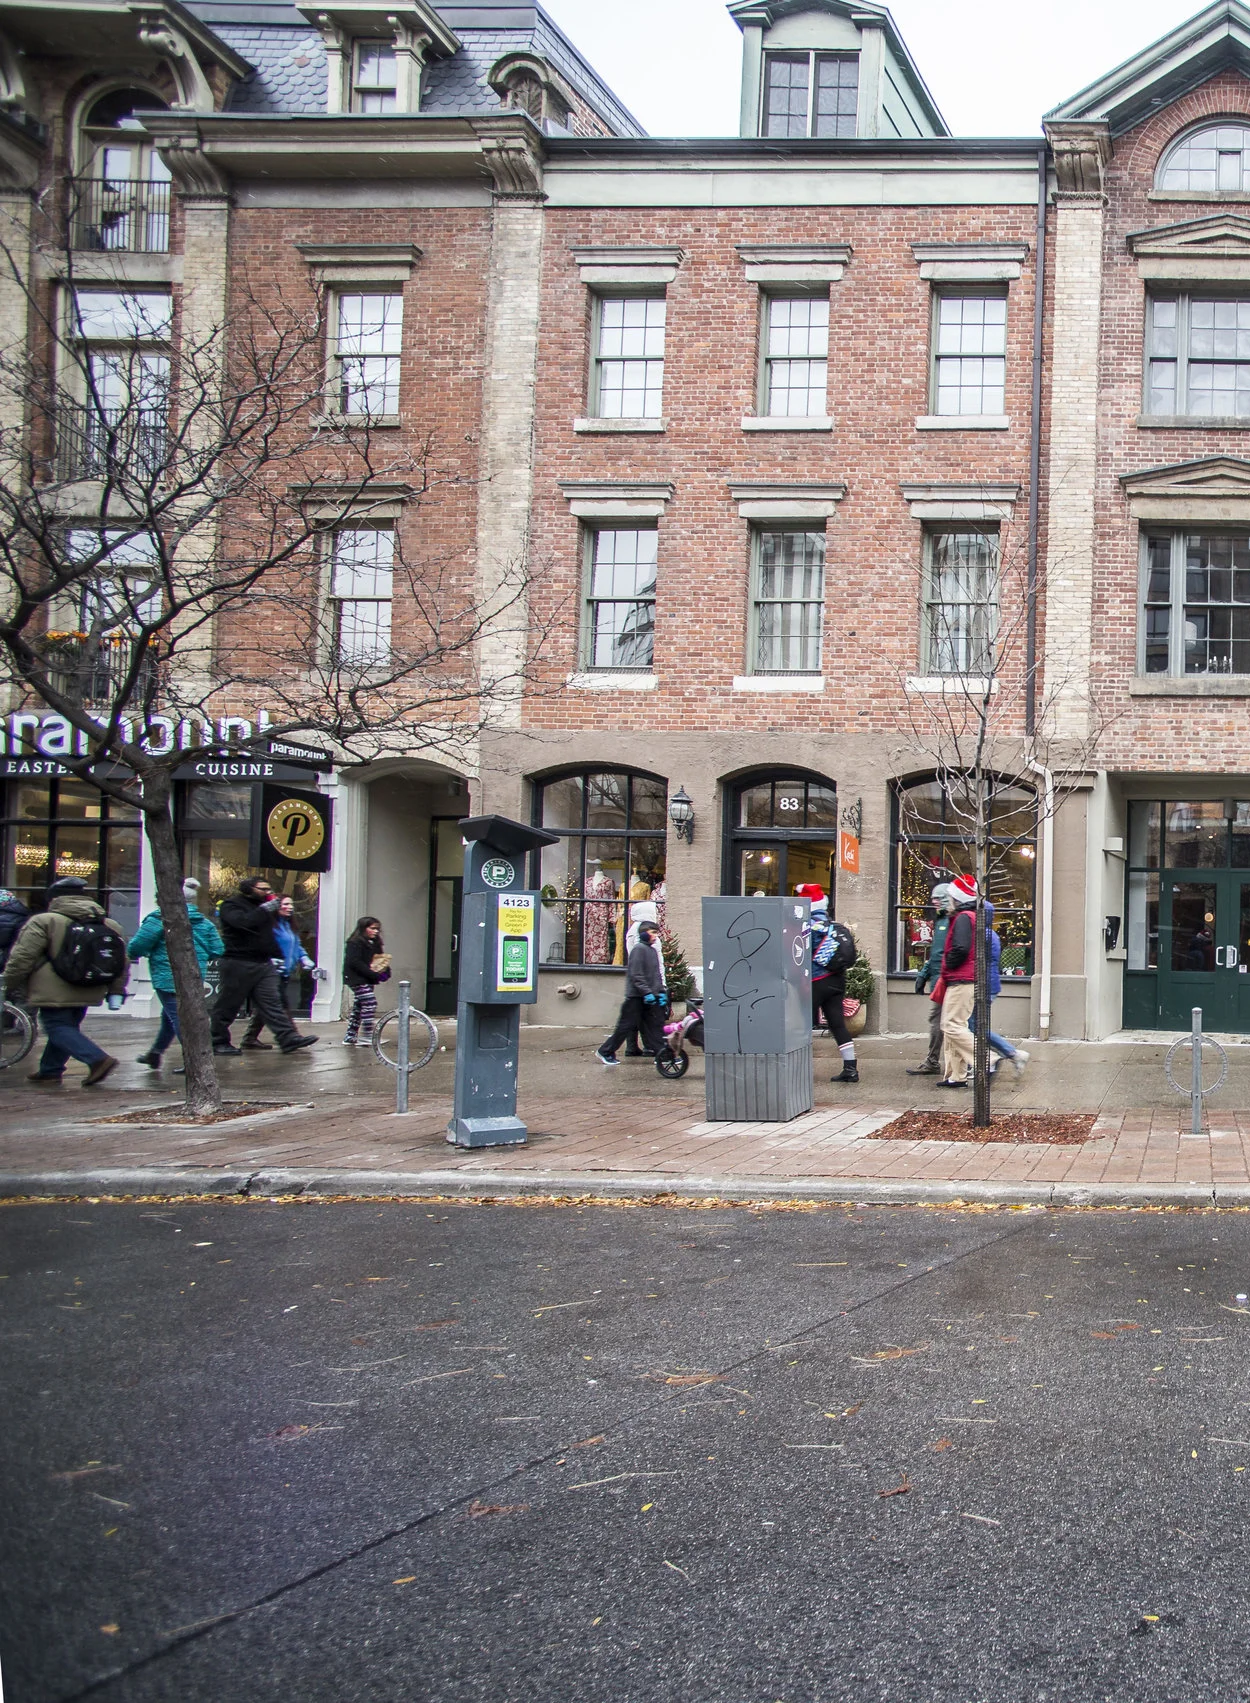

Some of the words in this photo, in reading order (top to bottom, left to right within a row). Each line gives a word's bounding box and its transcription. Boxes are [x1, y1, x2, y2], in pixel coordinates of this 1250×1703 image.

[196, 763, 273, 776] CUISINE
[780, 797, 799, 811] 83
[503, 898, 530, 907] 4123
